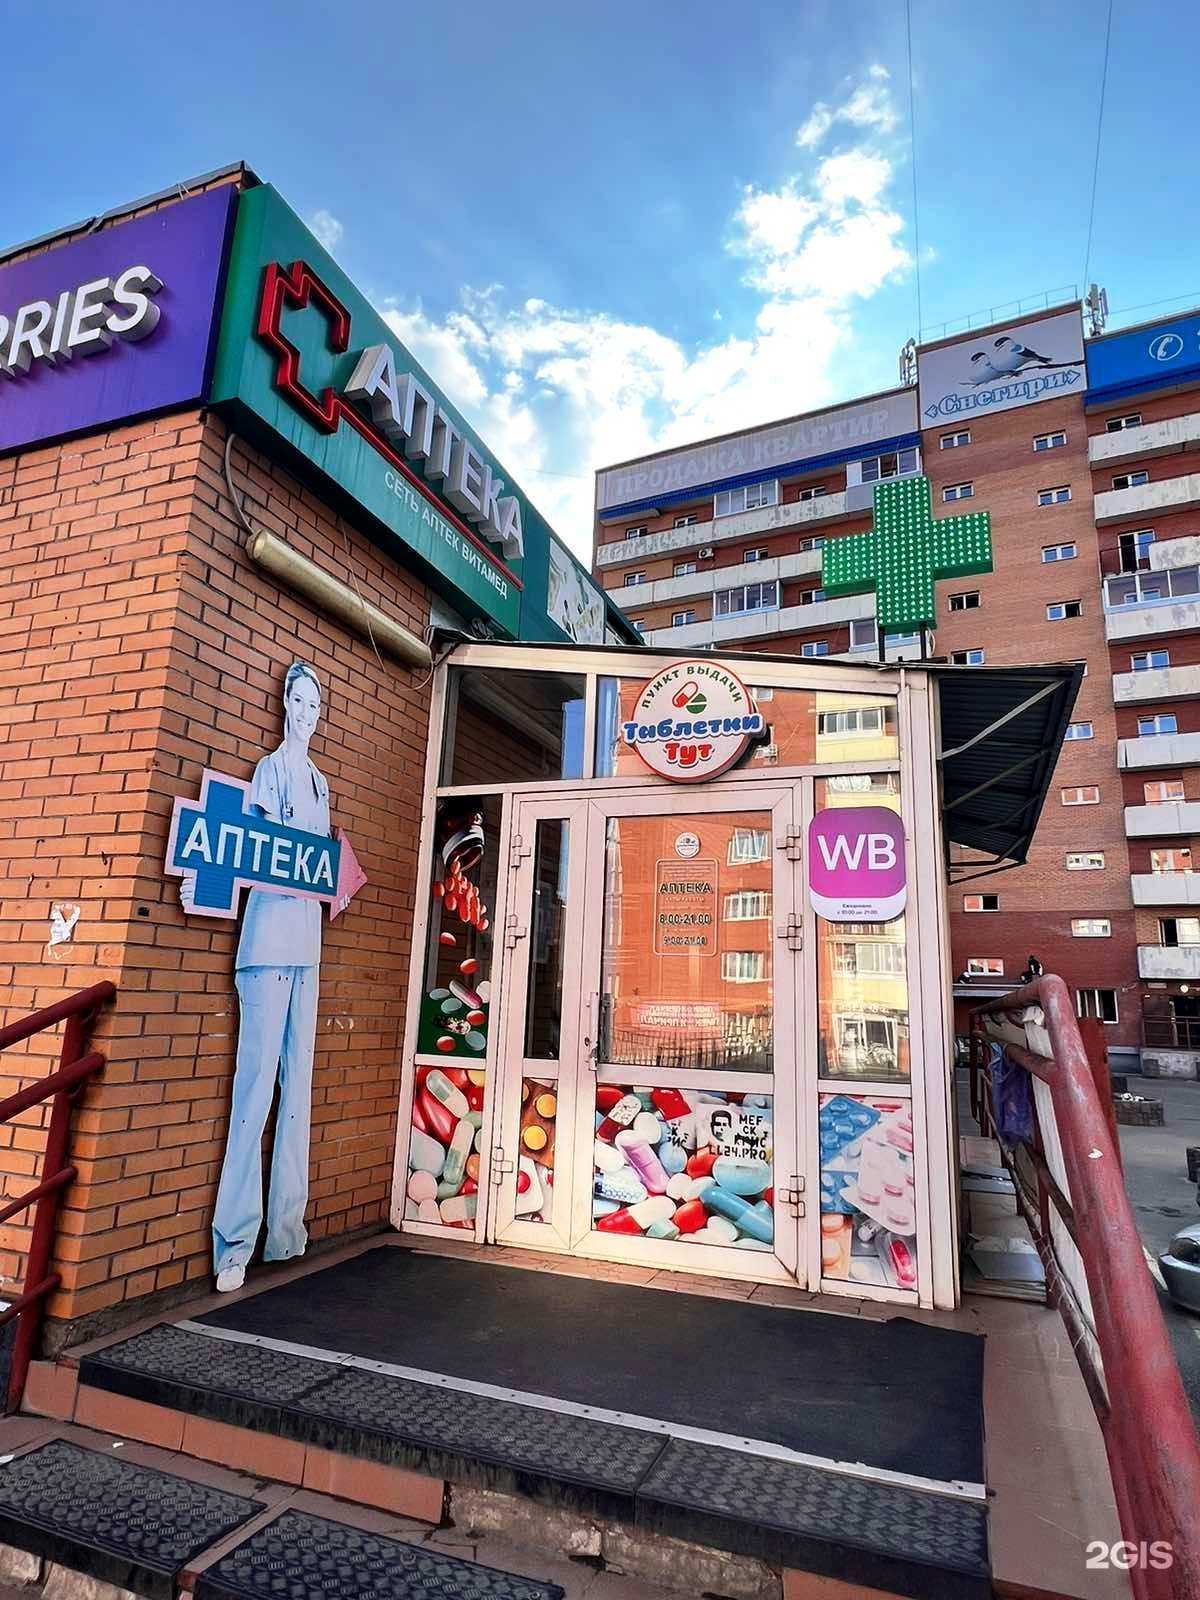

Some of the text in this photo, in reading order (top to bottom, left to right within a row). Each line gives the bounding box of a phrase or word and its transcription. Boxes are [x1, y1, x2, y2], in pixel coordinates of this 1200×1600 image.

[344, 343, 524, 560] АПТЕКА
[615, 410, 889, 494] ПРОДАЖА КВАРТИР
[384, 471, 508, 600] СЕТЬ АПТЕК ВИТАМЕД
[641, 665, 743, 709] ПУНКТ ВЫДАЧИ
[623, 714, 761, 741] Таблетки
[664, 742, 713, 766] Тут
[181, 817, 334, 888] АПТЕКА
[816, 832, 897, 871] WB
[659, 882, 713, 894] АПТЕКА
